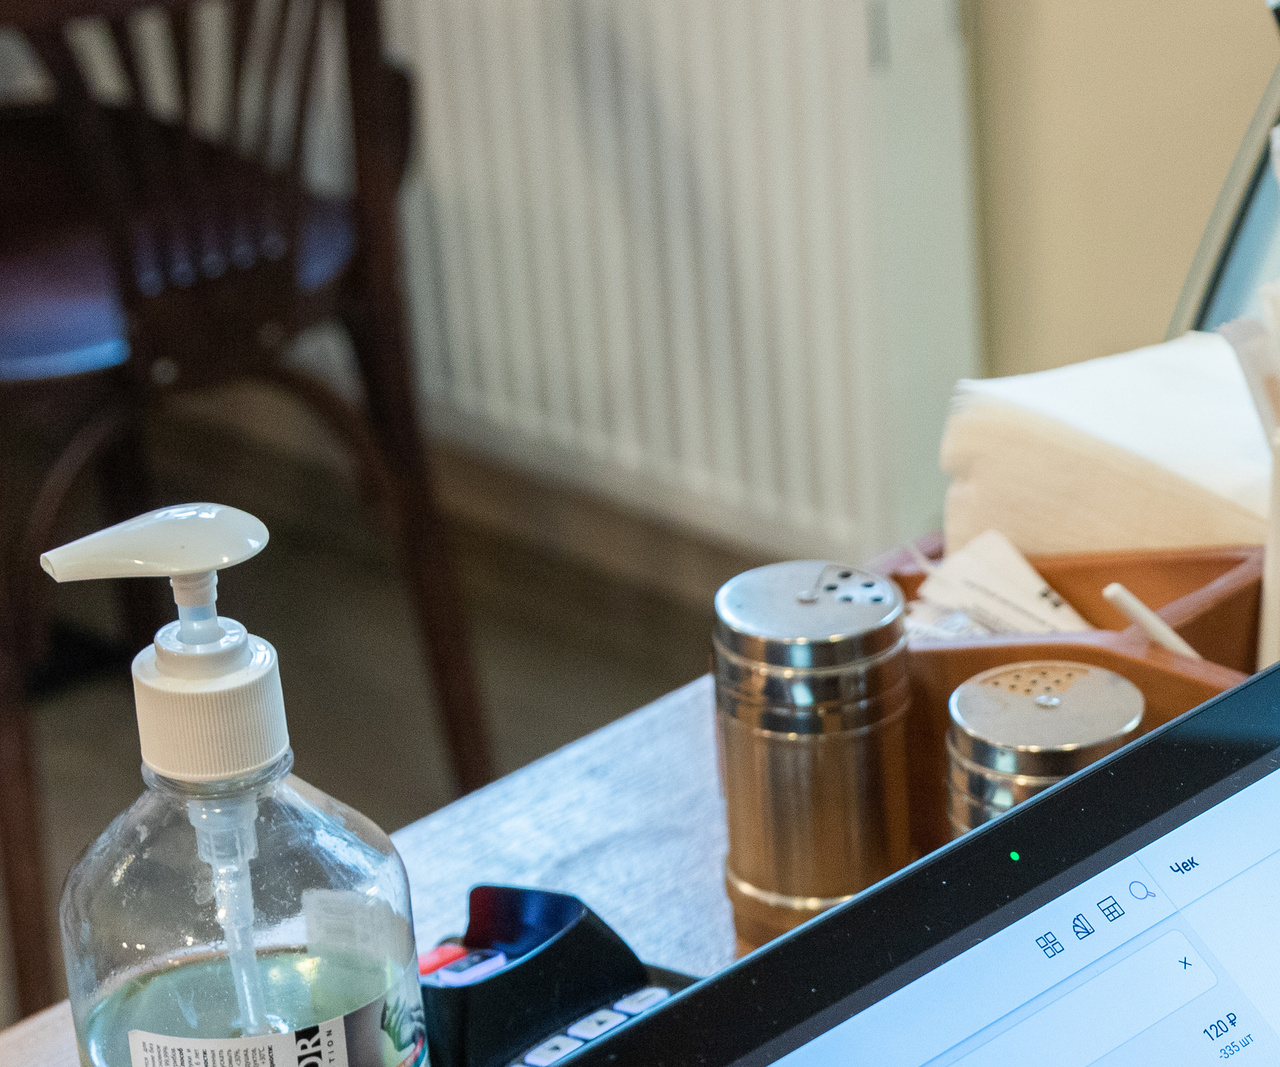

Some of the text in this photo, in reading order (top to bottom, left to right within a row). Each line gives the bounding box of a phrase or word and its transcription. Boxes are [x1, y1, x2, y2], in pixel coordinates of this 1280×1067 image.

[1169, 856, 1200, 876] Чек
[1203, 1019, 1229, 1041] 120
[1219, 1033, 1255, 1060] -335 шт
